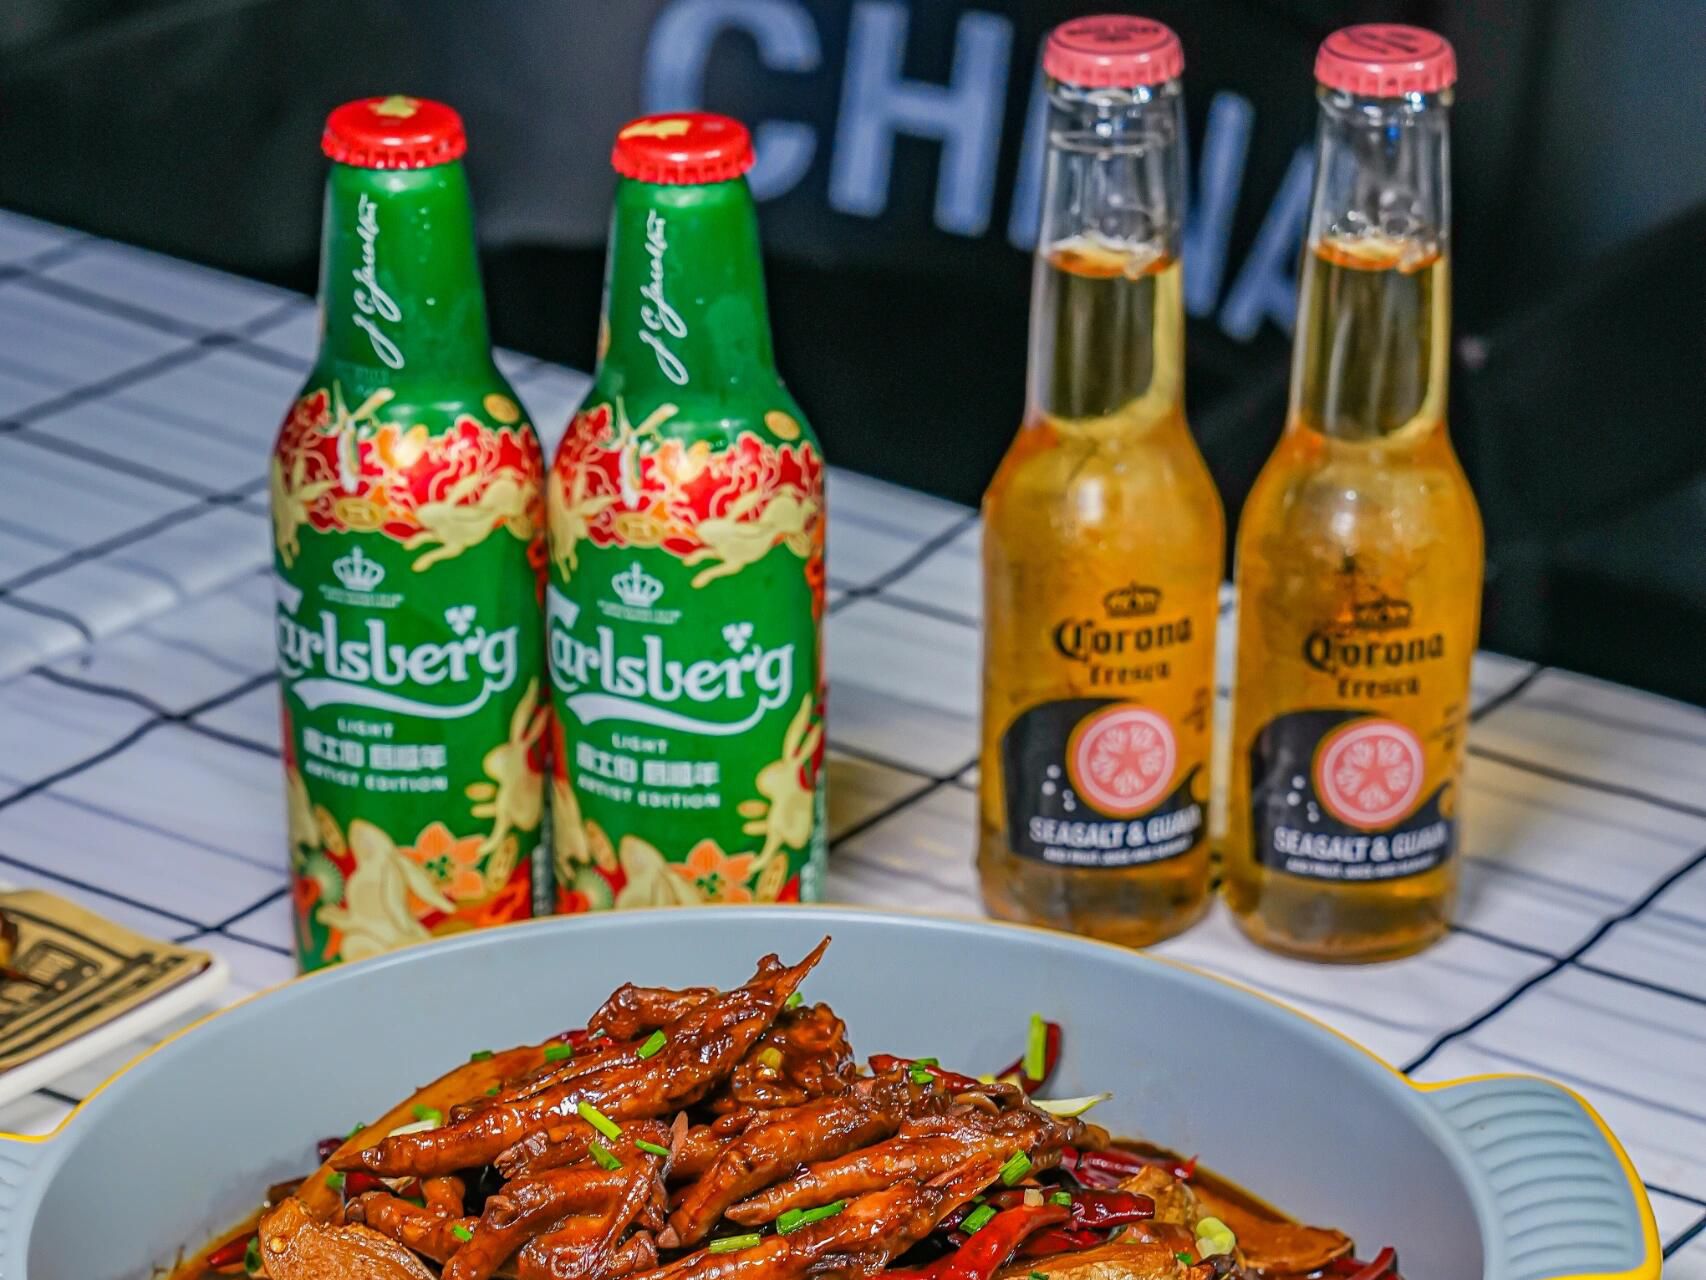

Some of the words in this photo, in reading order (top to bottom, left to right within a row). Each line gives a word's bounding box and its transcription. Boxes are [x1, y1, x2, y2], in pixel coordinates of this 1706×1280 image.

[546, 584, 795, 709] Carlsberg
[1054, 617, 1192, 662] Corona
[1304, 630, 1444, 674] Corona
[338, 718, 394, 739] LIGHT
[612, 732, 667, 755] LIGHT
[364, 774, 449, 792] EDITION
[637, 790, 721, 809] EDITION
[1029, 815, 1126, 849] SEASALT
[1126, 820, 1146, 848] &
[1273, 825, 1370, 863] SEASALT
[1369, 835, 1391, 862] &
